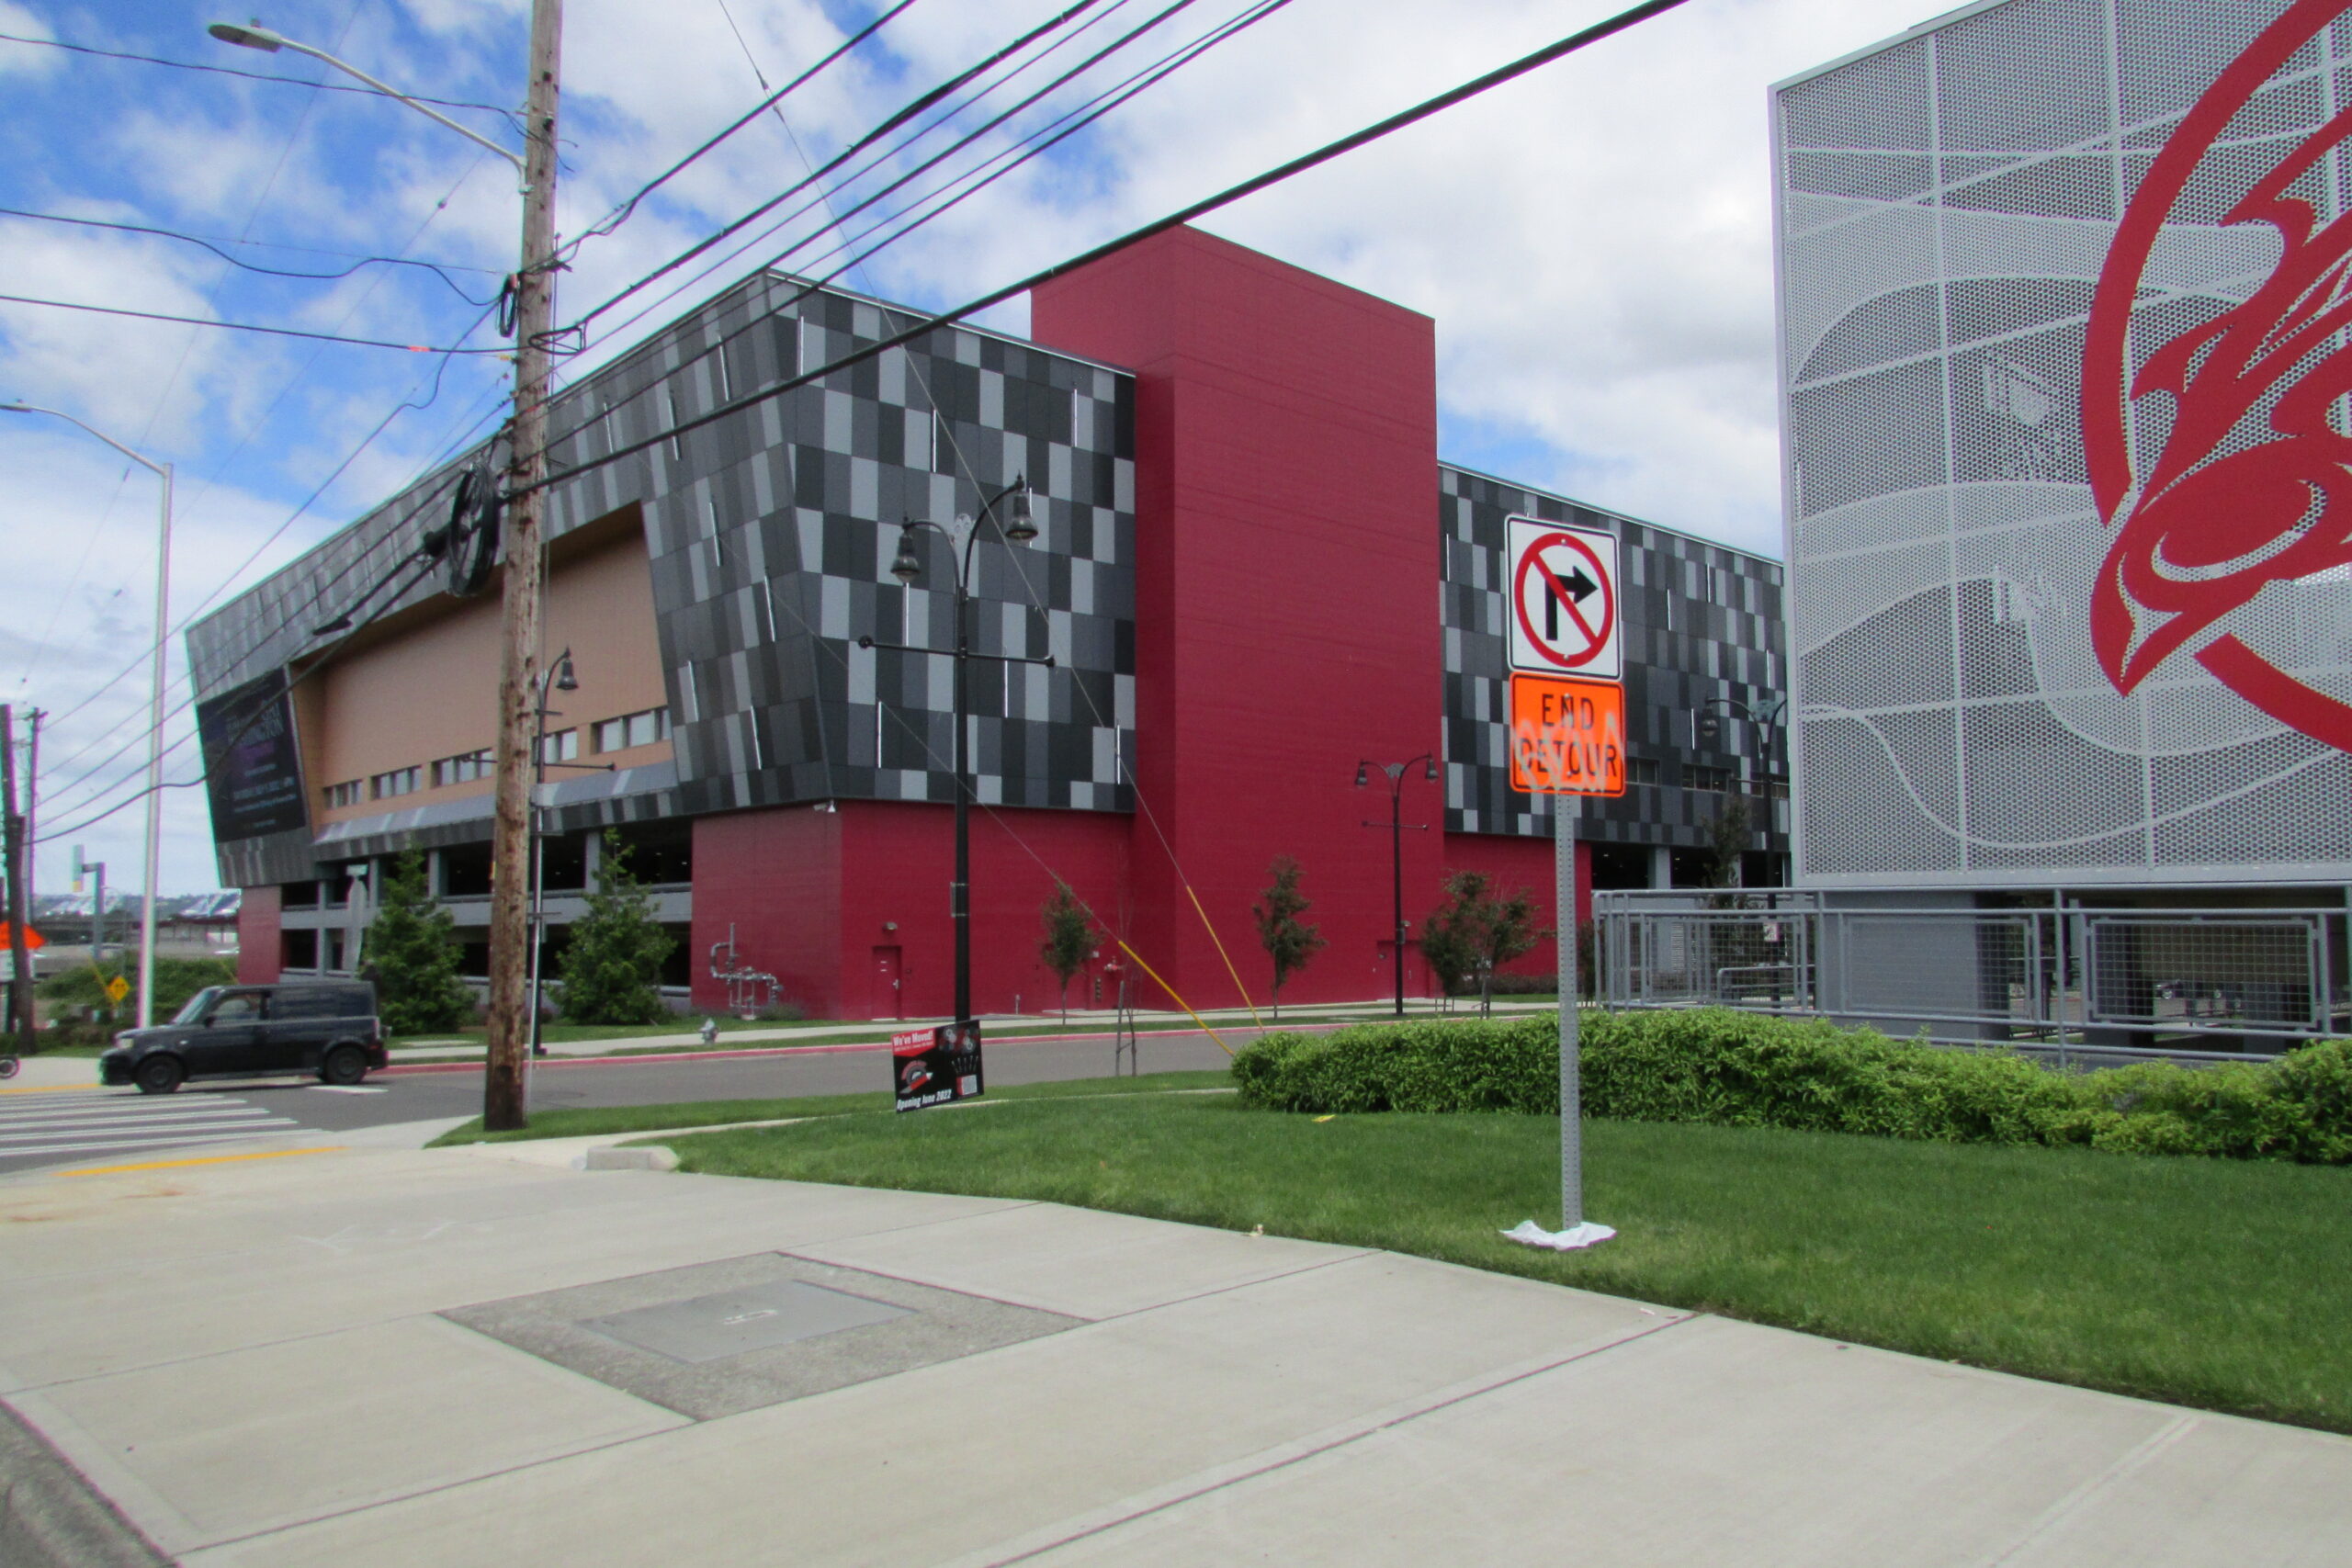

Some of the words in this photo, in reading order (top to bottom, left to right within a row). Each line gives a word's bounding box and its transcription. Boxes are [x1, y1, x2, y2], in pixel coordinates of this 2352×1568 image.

[1542, 694, 1594, 730] END
[1521, 738, 1617, 777] DETOUR
[894, 1035, 911, 1045] We've
[897, 1097, 921, 1111] Opening
[922, 1094, 935, 1104] June
[936, 1089, 952, 1101] 2022
